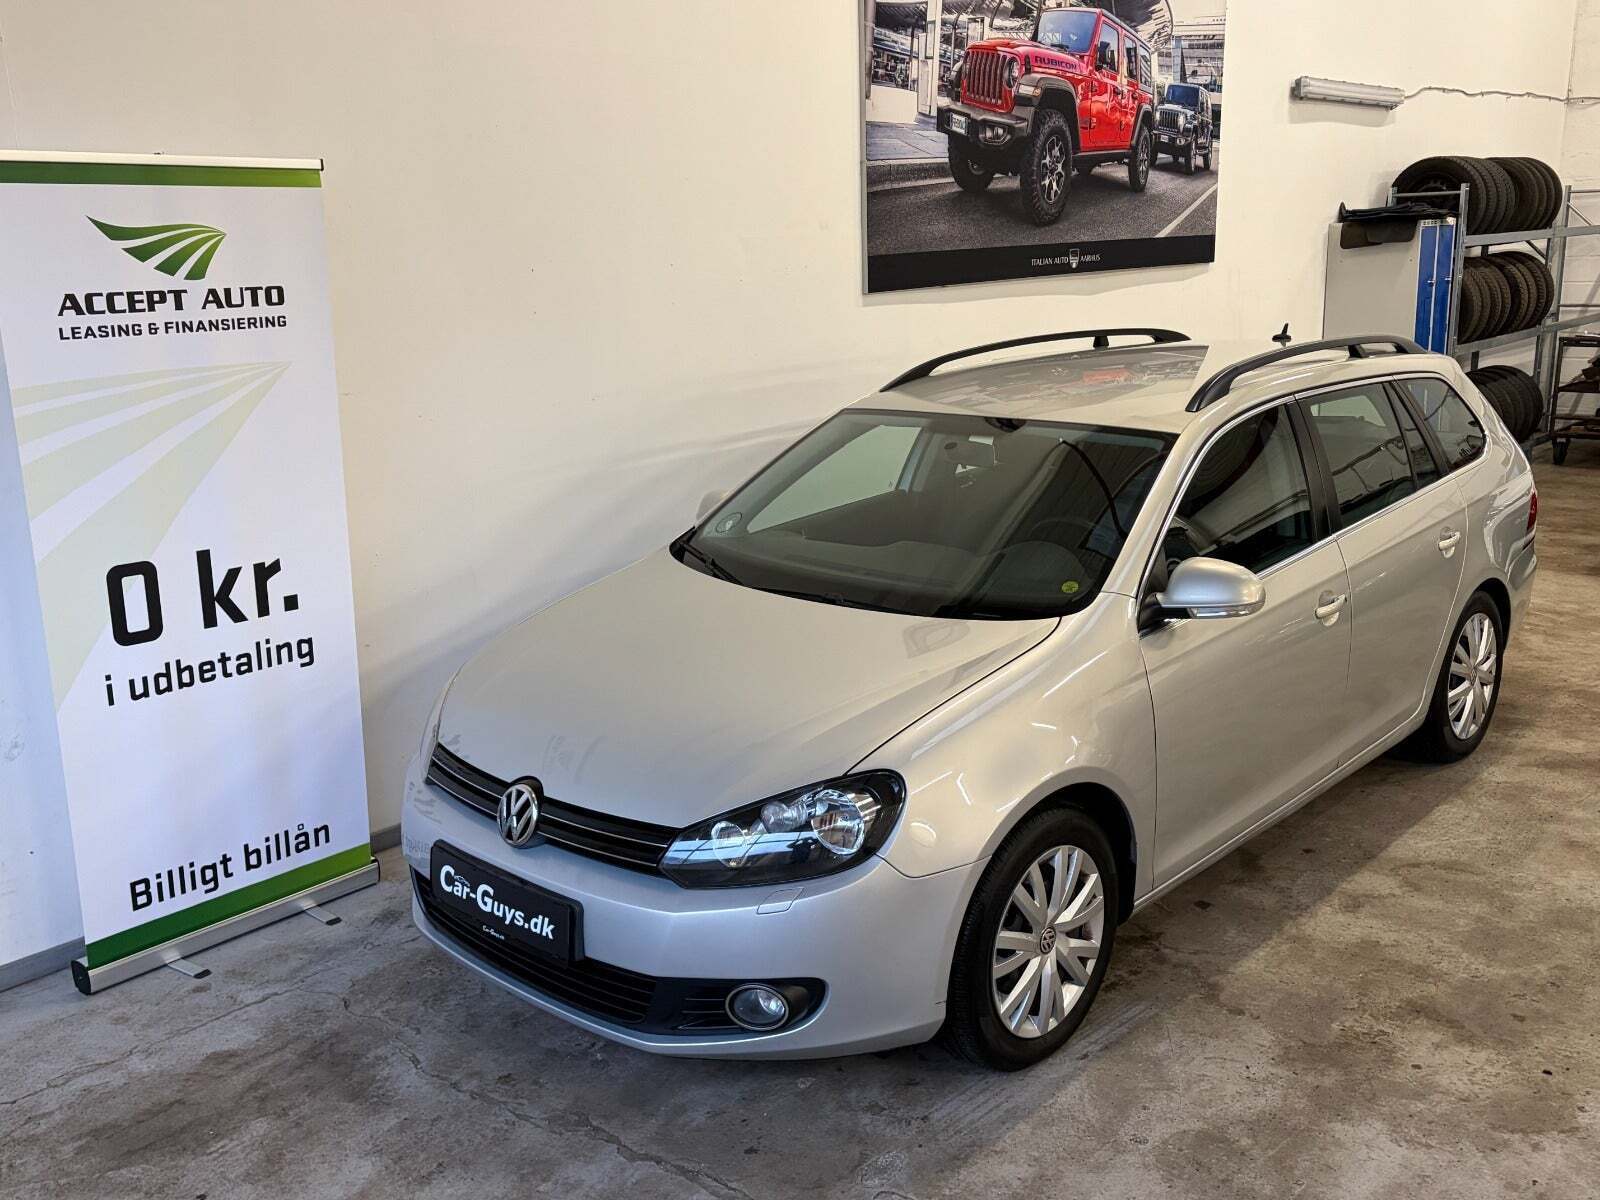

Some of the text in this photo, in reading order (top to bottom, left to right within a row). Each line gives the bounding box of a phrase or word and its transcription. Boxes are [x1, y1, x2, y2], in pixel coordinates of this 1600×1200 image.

[1035, 55, 1077, 70] RUBICON
[1032, 257, 1053, 266] ITALIAN
[1054, 256, 1069, 264] AUTO
[57, 285, 285, 317] ACCEPT AUTO
[58, 315, 287, 341] LEASING & FINANSIERING
[106, 548, 299, 647] 0 kr.
[105, 636, 315, 707] i udbetaling
[129, 822, 331, 912] Billigt billån
[439, 864, 556, 940] Car-Guys.dk
